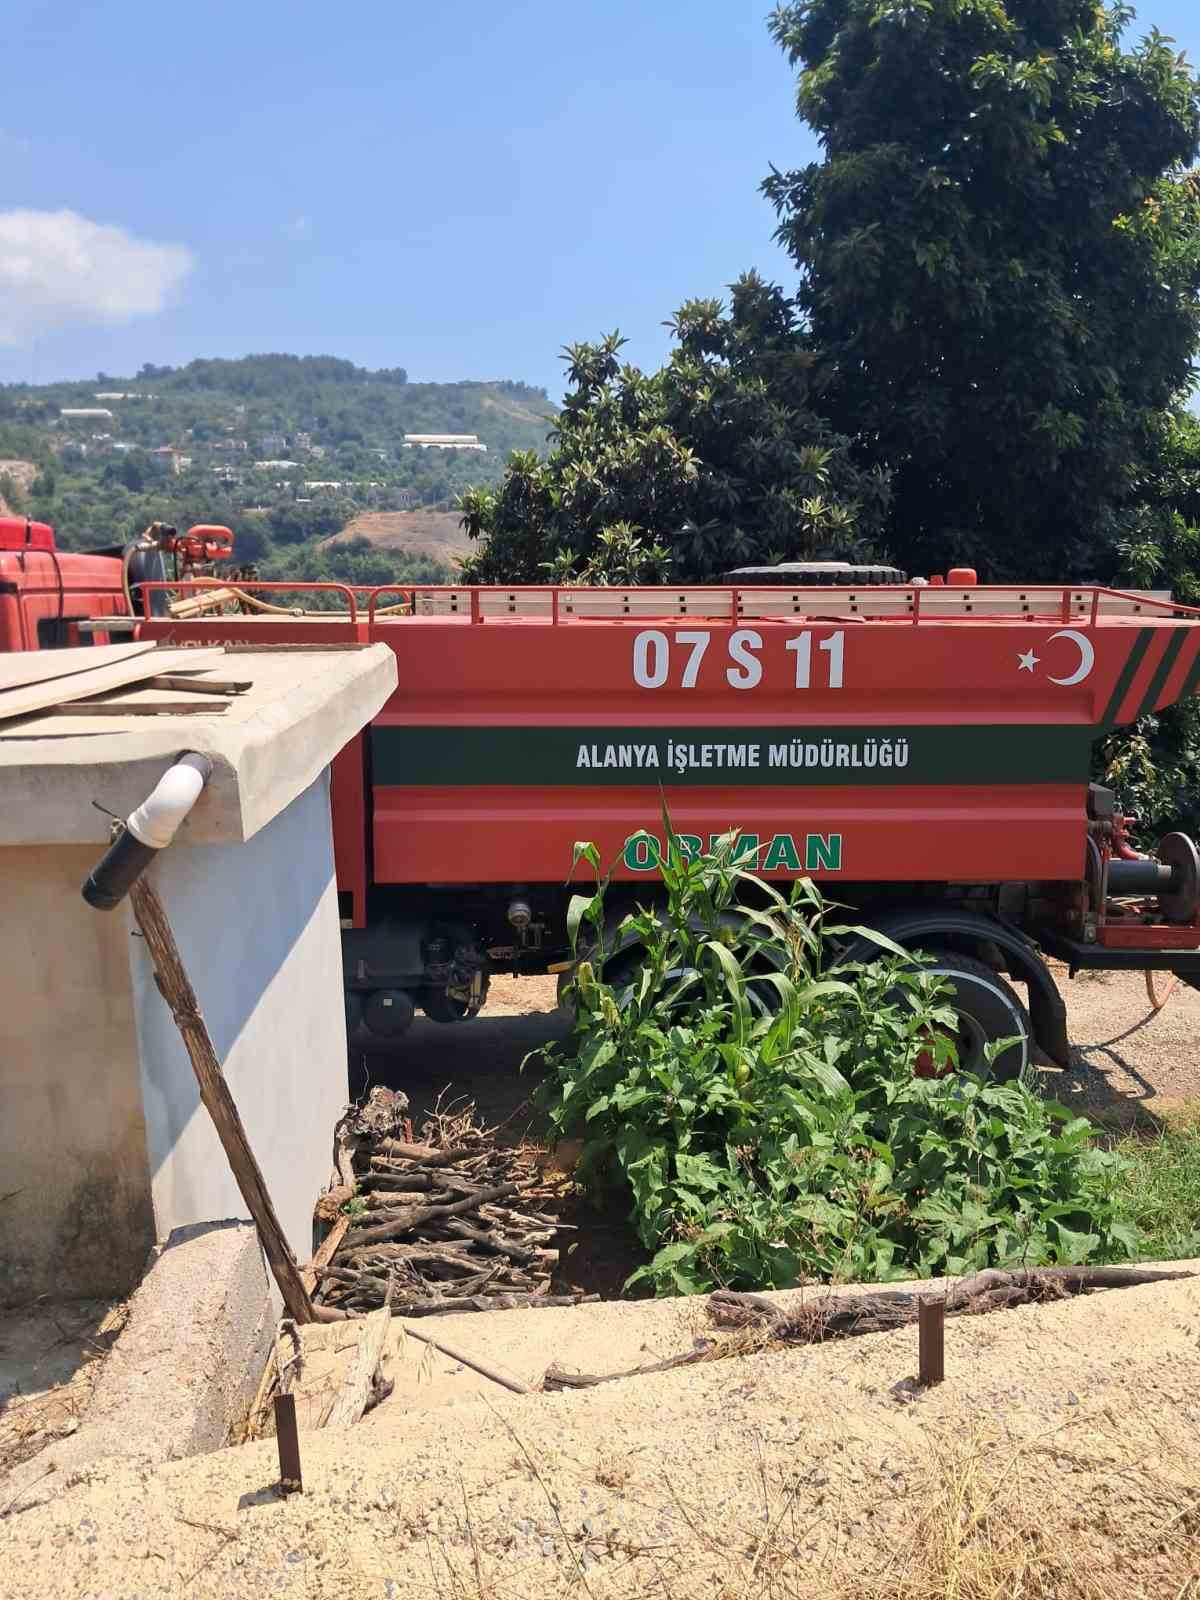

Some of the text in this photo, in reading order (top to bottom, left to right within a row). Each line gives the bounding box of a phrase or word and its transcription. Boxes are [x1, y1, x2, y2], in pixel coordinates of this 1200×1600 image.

[633, 629, 845, 690] 07 S 11
[575, 737, 910, 773] ALANYA İŞLETME MÜDÜRLÜĞÜ
